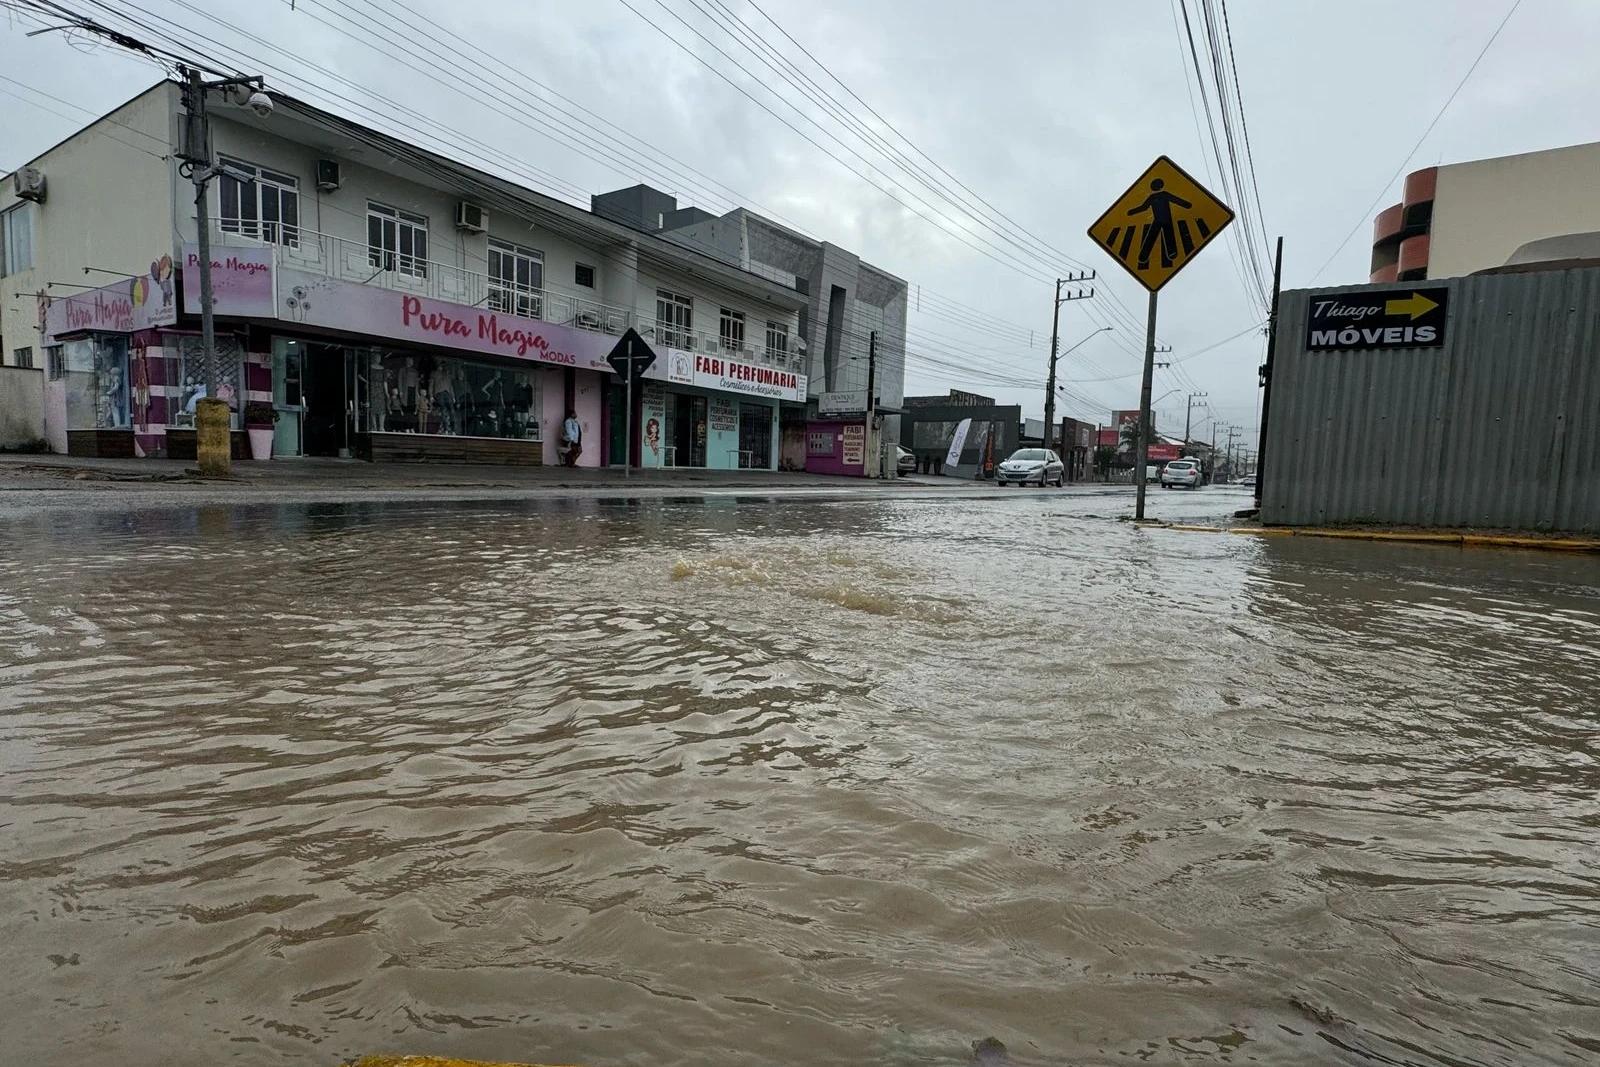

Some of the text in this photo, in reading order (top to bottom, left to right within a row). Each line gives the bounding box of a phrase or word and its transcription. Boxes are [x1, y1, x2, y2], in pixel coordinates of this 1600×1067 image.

[227, 257, 269, 275] Magia
[1314, 301, 1382, 321] Thiago
[403, 296, 549, 356] Pura Magia
[1311, 325, 1437, 346] MÓVEIS
[540, 351, 576, 365] MODAS
[695, 356, 724, 377] FABI
[729, 363, 797, 389] PERFUMARIA
[846, 426, 863, 434] FABI
